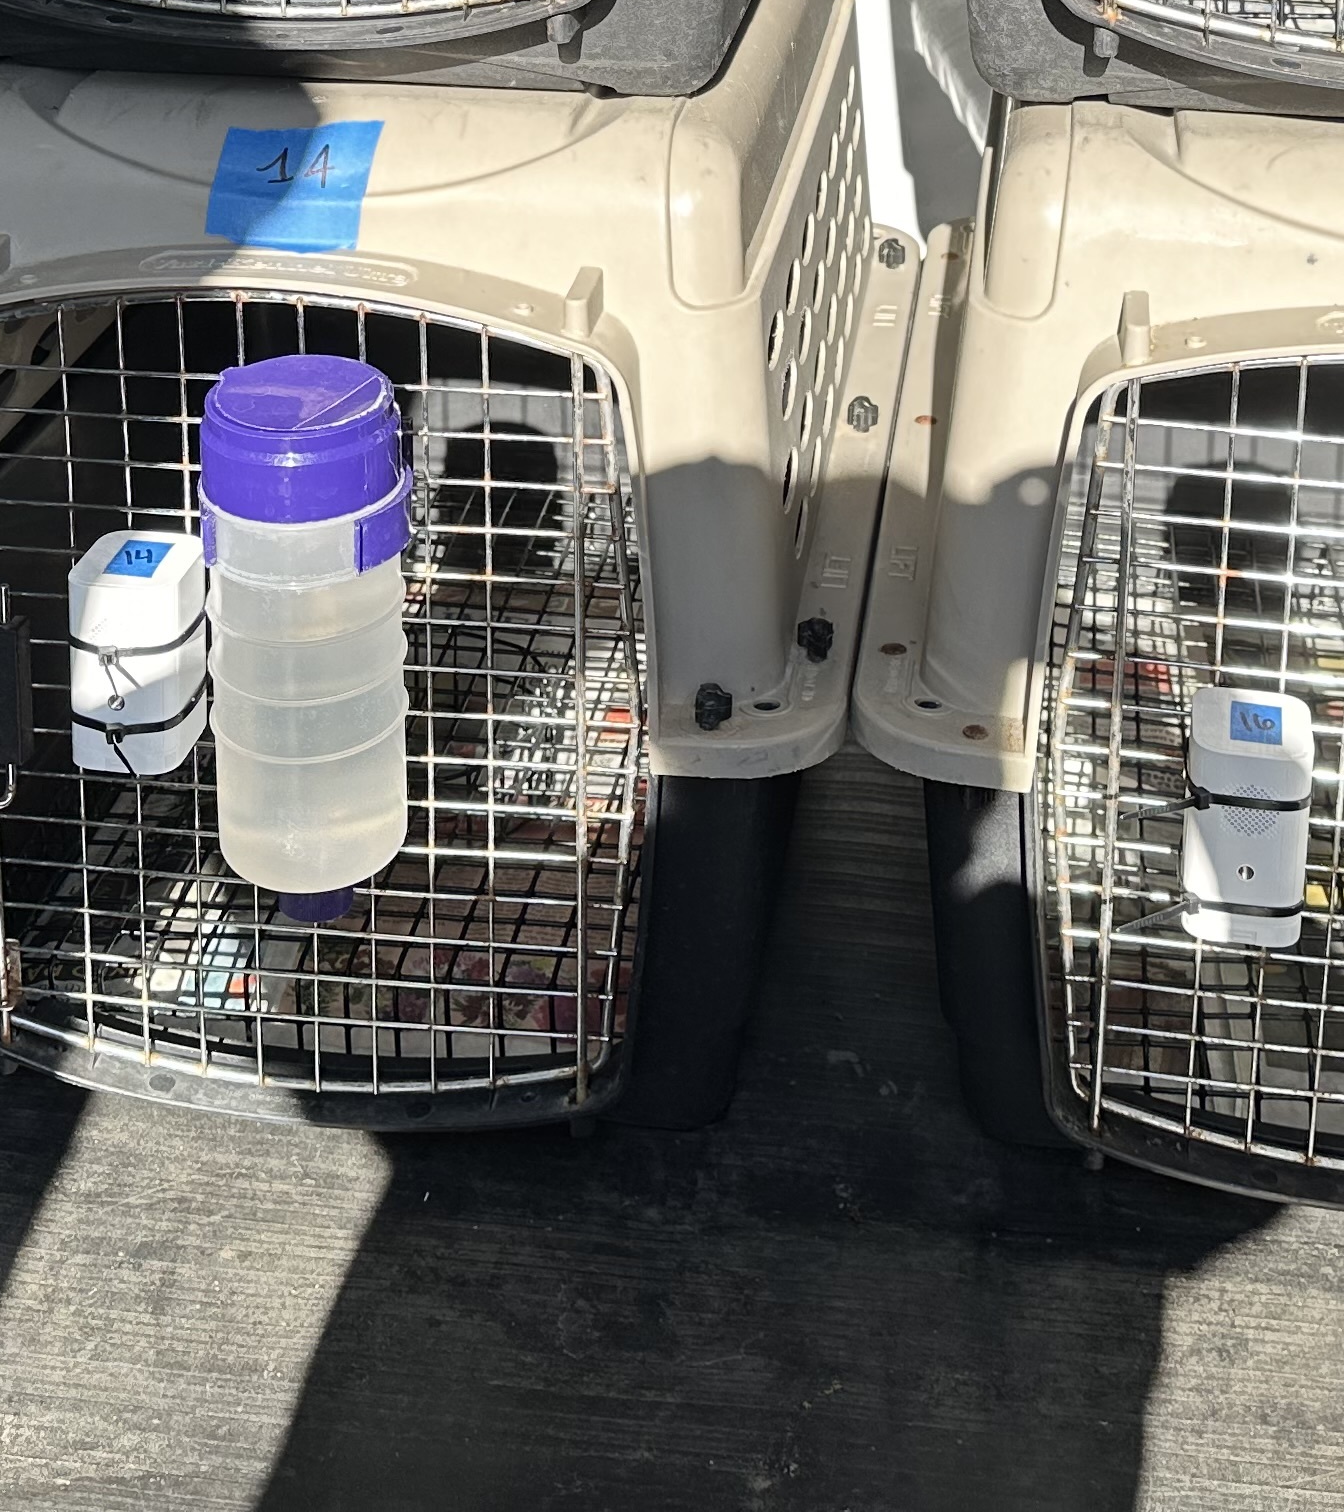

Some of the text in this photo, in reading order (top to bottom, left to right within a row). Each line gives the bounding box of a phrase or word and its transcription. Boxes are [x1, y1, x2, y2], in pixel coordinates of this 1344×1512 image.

[256, 143, 335, 189] 14
[123, 547, 154, 566] 14
[1238, 710, 1277, 733] 16
